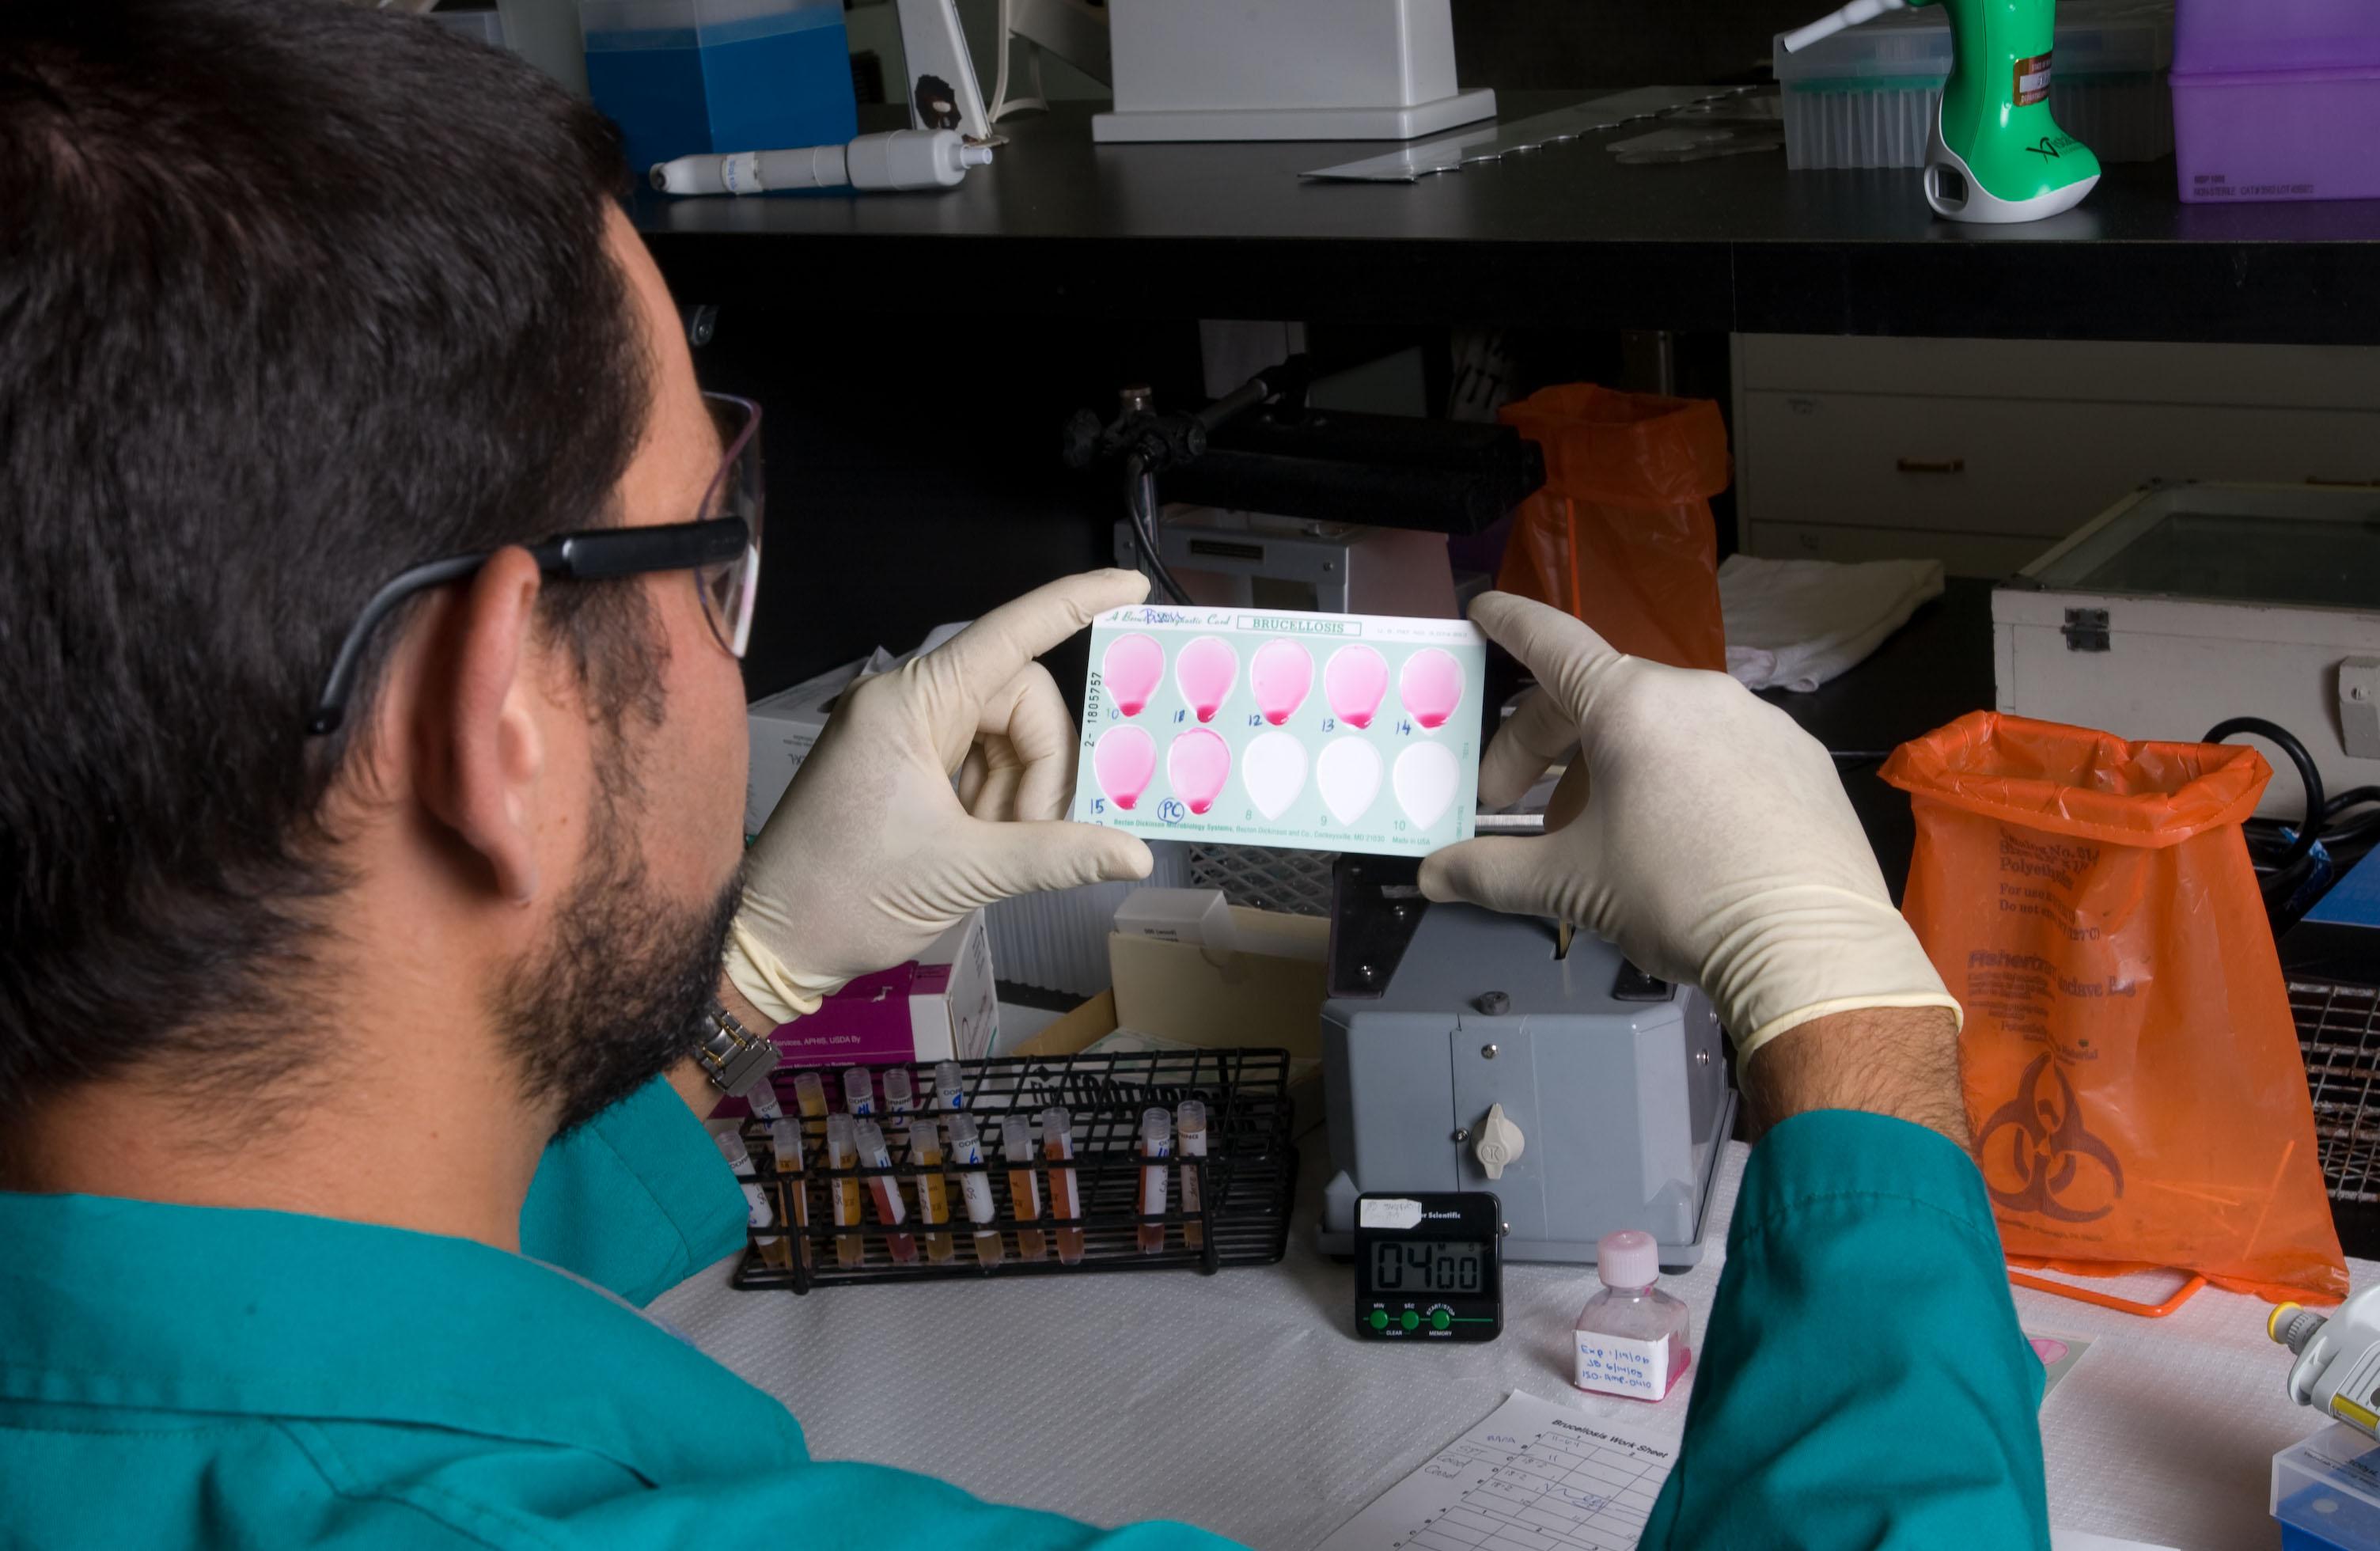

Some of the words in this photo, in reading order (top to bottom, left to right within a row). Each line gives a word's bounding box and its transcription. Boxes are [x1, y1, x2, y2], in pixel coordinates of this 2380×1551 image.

[1253, 618, 1344, 633] BRUCELLOSIS
[1249, 715, 1263, 726] 12
[1321, 719, 1335, 733] 13
[1397, 721, 1412, 735] 14
[1090, 798, 1105, 815] 15
[1163, 801, 1183, 818] PC
[1245, 810, 1253, 821] 8
[1321, 816, 1328, 827] 9
[1135, 820, 1165, 829] Dickinson
[1166, 822, 1206, 832] Microbiology
[1393, 821, 1406, 831] 10
[1999, 899, 2016, 911] Do
[2020, 902, 2039, 914] not
[830, 1035, 850, 1044] USDA
[851, 1034, 861, 1044] By
[1428, 1211, 1461, 1219] Scientific
[1426, 1303, 1456, 1317] START/STOP
[1581, 1344, 1603, 1359] Exp
[1552, 1419, 1607, 1440] Brucellosis
[1609, 1436, 1637, 1449] Work
[1636, 1445, 1669, 1458] Sheet
